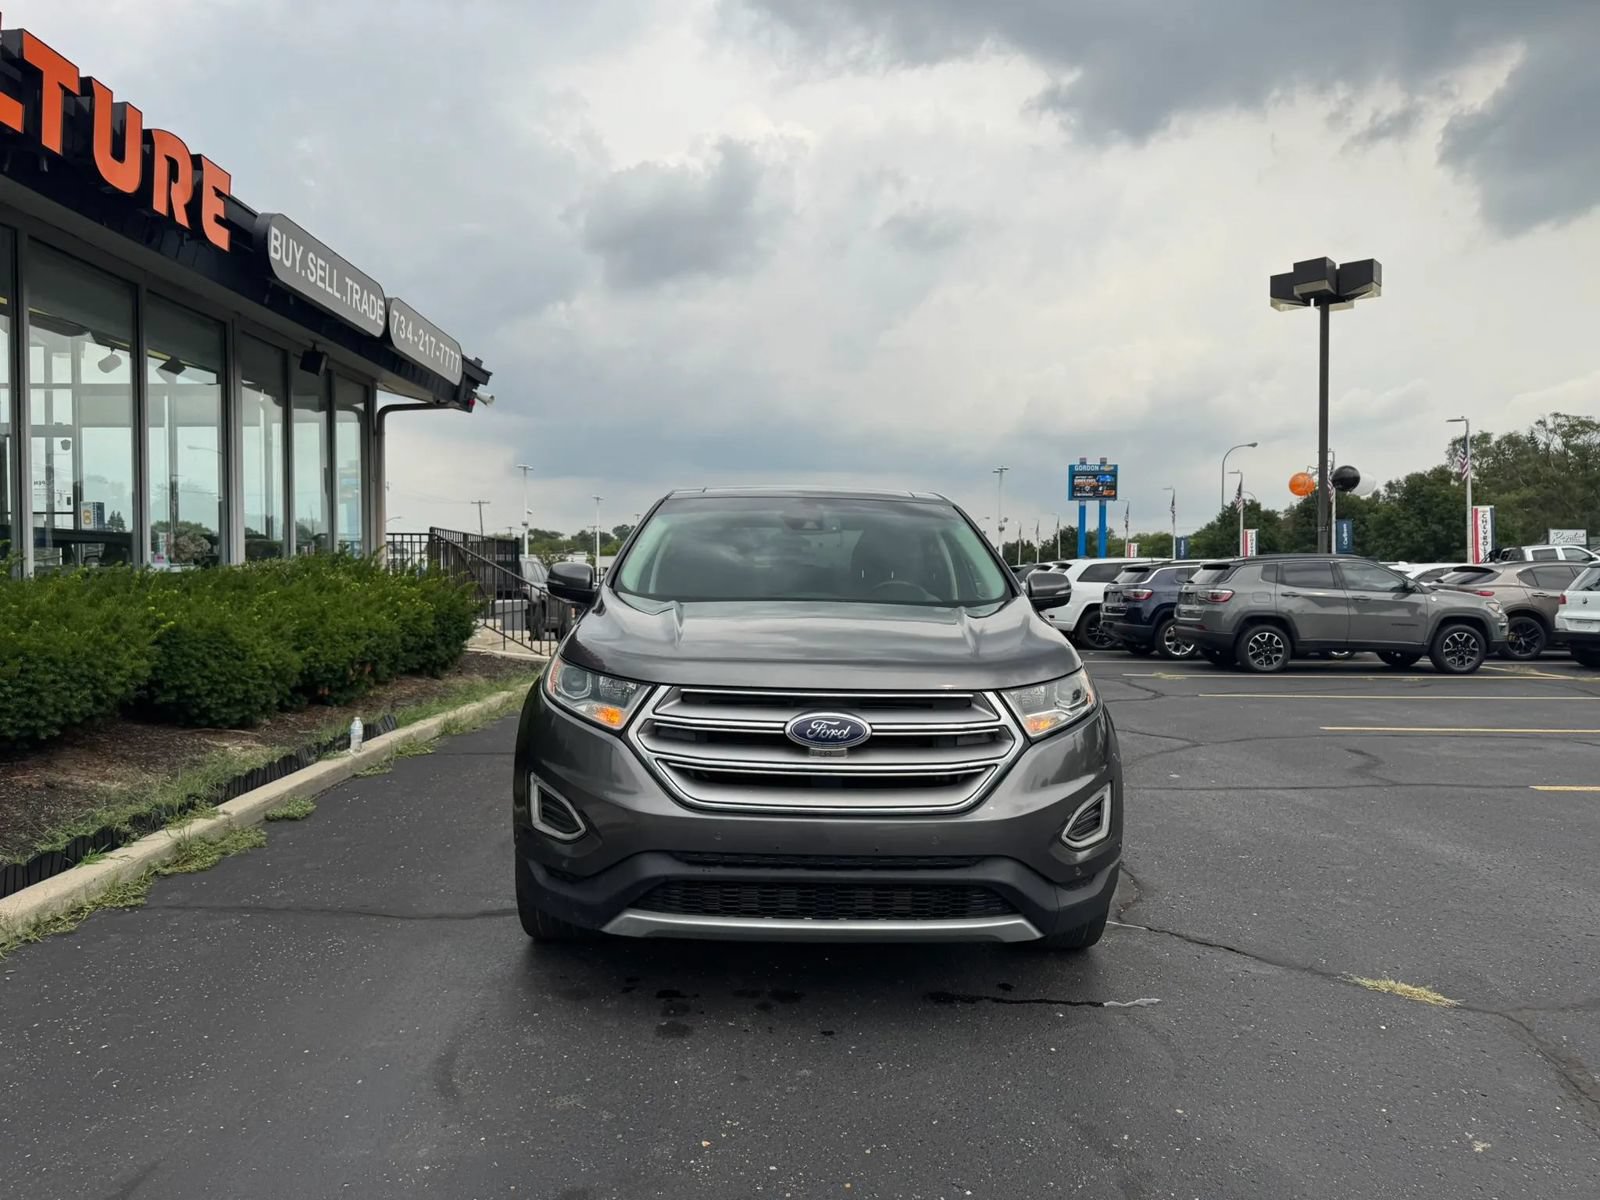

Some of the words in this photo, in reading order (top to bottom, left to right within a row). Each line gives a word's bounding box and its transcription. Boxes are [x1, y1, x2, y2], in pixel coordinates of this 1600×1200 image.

[0, 29, 231, 252] TURE
[393, 311, 460, 374] 734-217-7777
[806, 720, 851, 739] Ford
